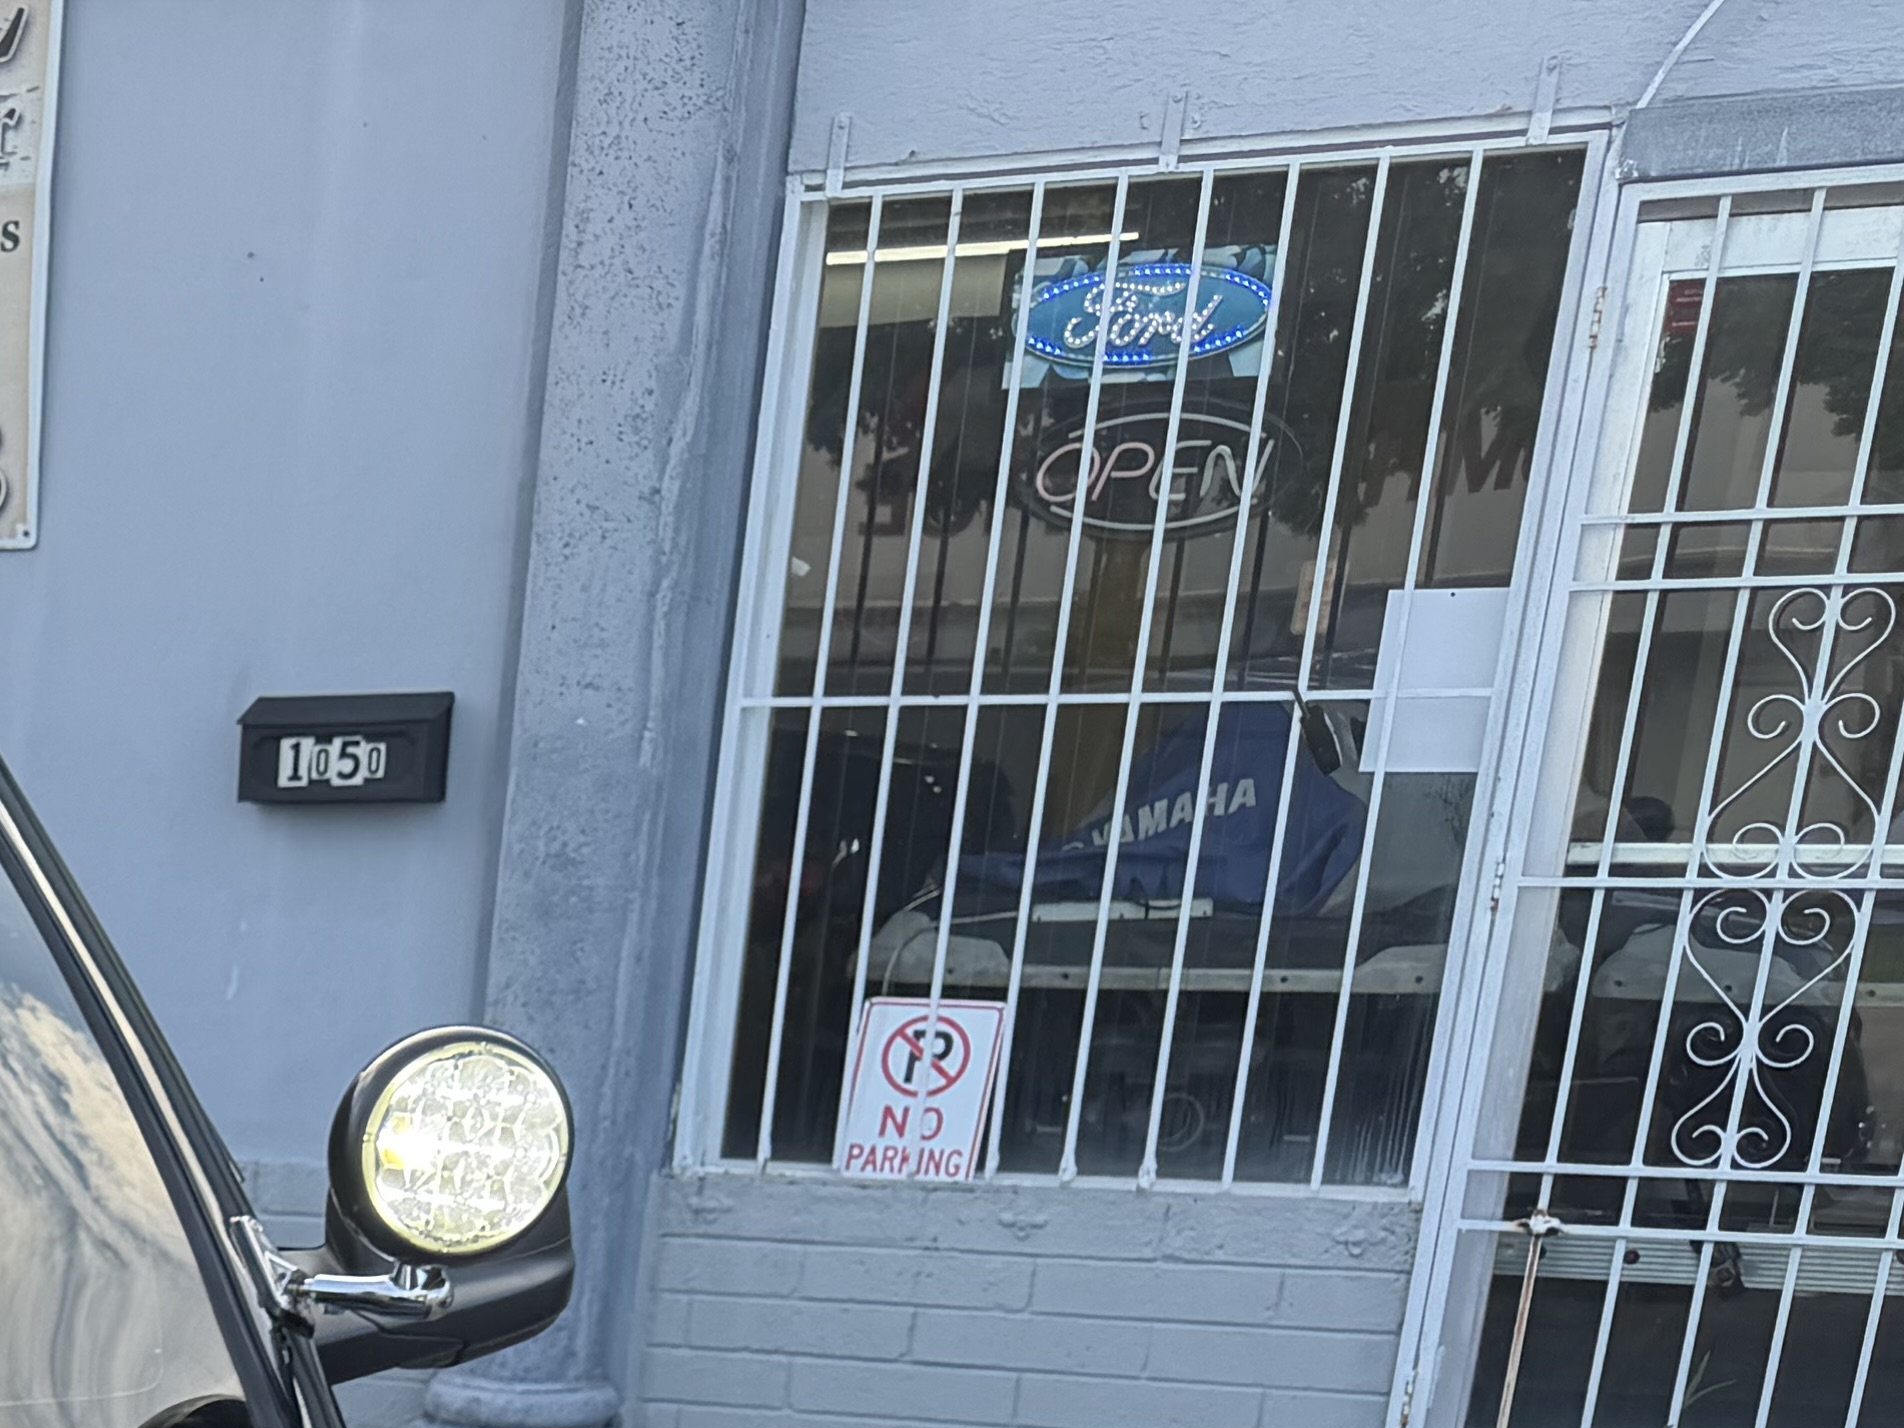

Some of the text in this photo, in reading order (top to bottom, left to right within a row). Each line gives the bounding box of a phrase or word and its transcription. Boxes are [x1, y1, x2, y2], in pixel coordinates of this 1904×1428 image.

[1063, 280, 1224, 349] Ford
[1036, 438, 1275, 502] OPEN
[285, 739, 383, 783] 1050
[1091, 778, 1258, 848] YAMAHA
[878, 1104, 946, 1142] NO
